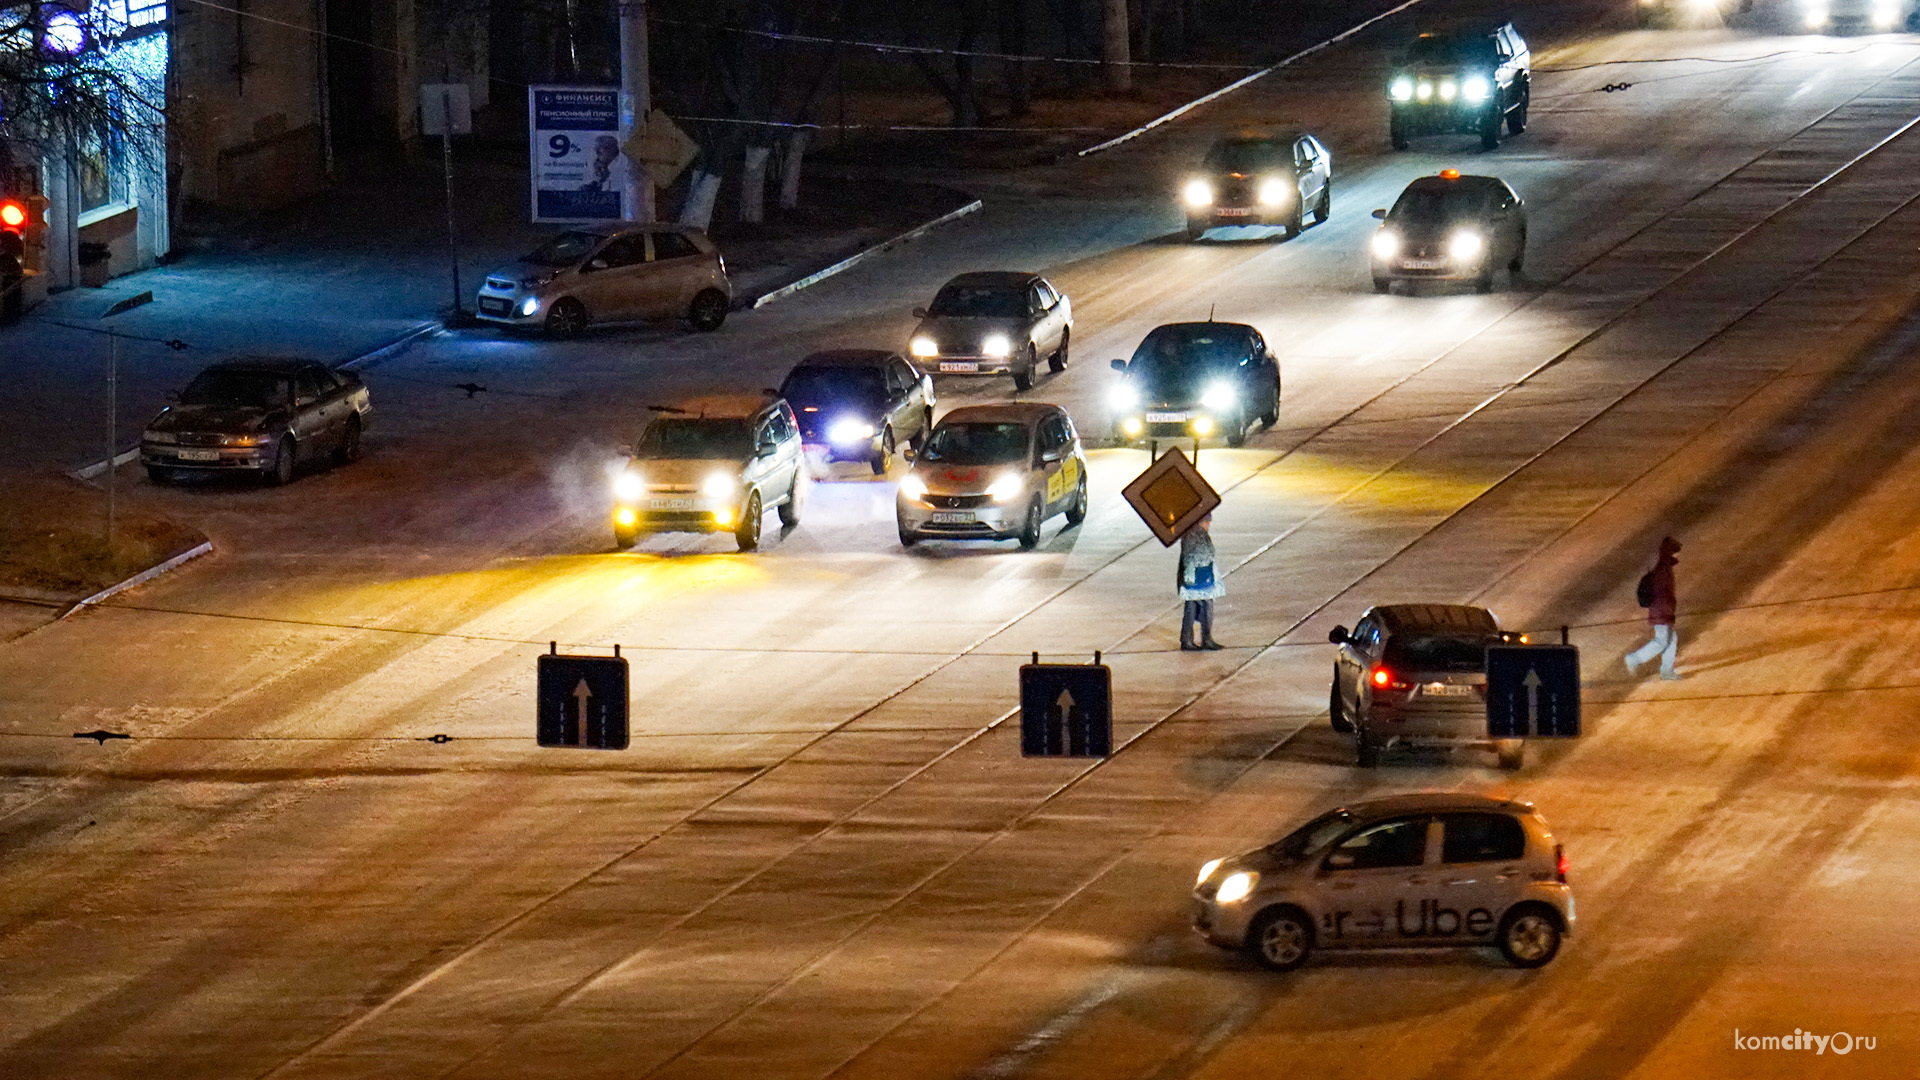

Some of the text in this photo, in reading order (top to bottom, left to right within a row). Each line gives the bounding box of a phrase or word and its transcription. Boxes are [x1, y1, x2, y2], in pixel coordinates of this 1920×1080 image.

[556, 94, 612, 102] ФИНАНСИСТ
[540, 109, 592, 117] ПЕНСИОННЫЙ
[549, 134, 581, 158] 9%
